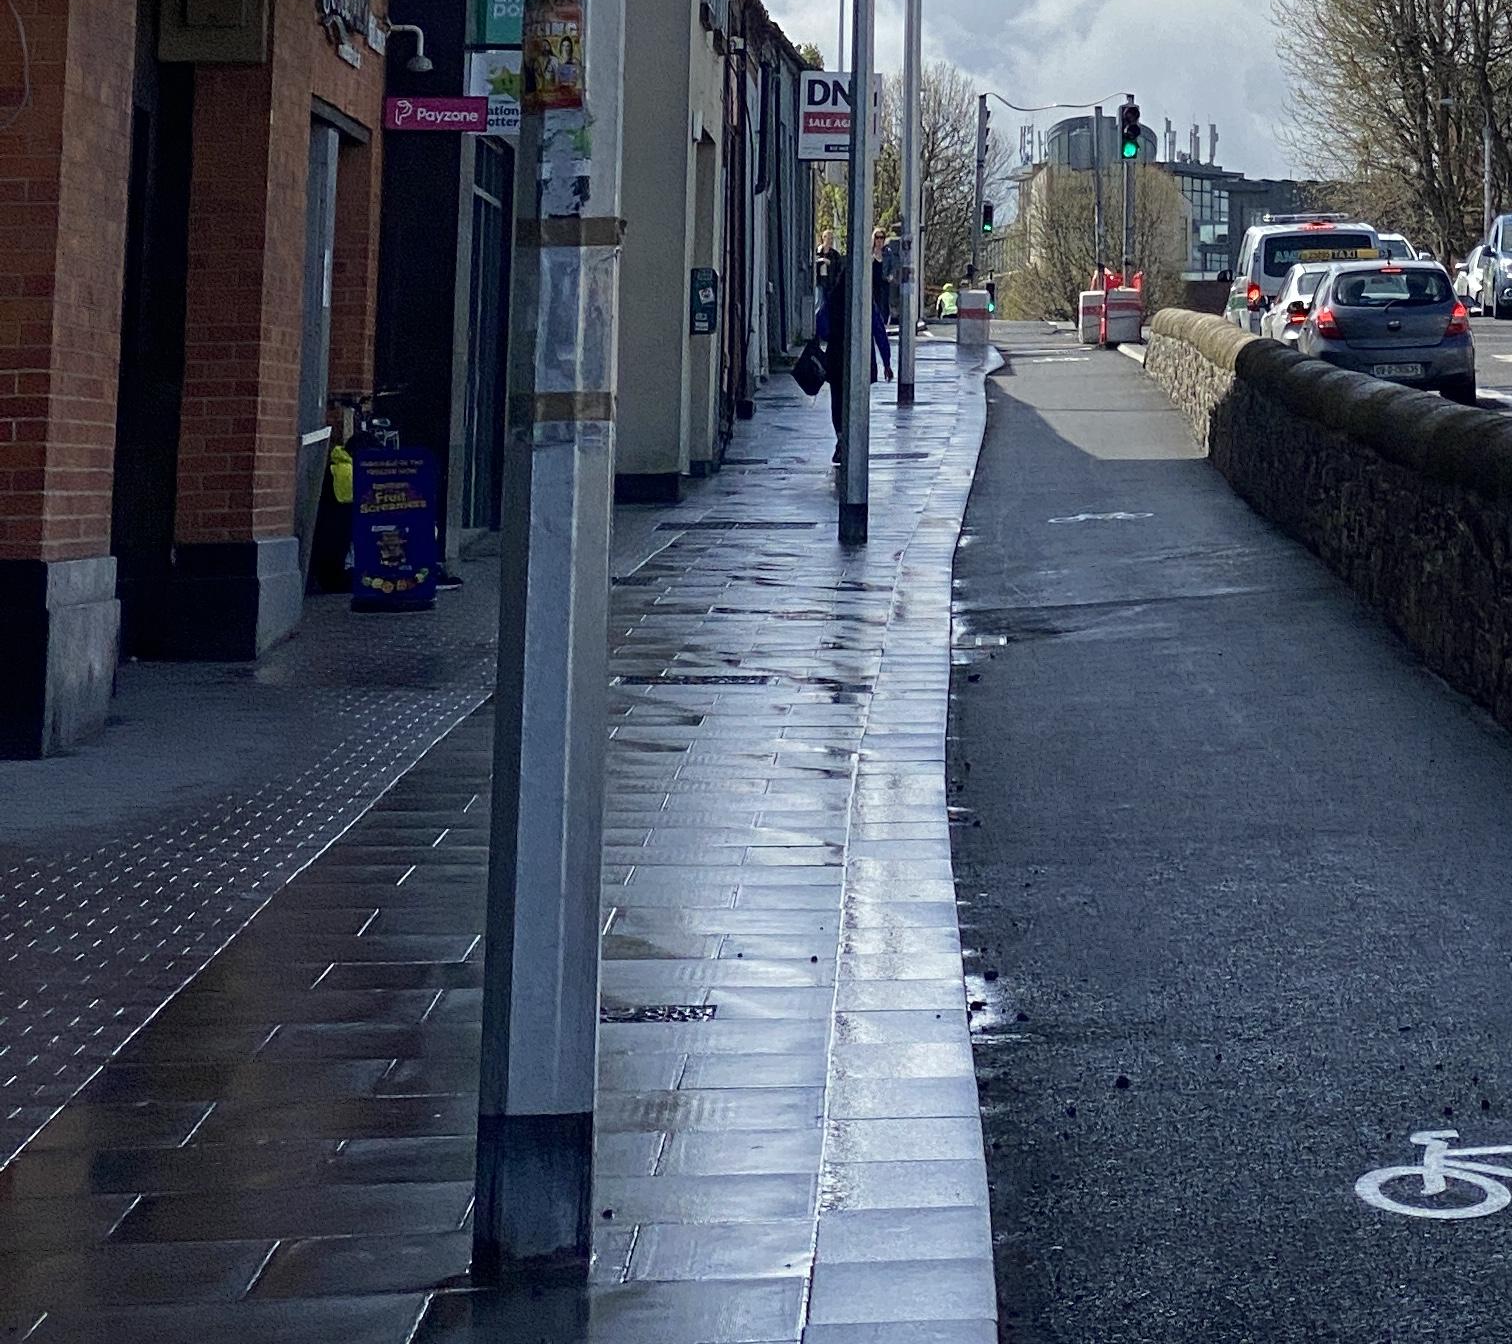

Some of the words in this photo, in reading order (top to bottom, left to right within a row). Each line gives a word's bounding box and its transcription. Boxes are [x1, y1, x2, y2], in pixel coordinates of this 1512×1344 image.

[493, 3, 523, 19] po
[417, 108, 479, 123] Payzone
[488, 117, 520, 127] otter
[808, 118, 831, 128] SALE
[1333, 249, 1357, 259] TAXI
